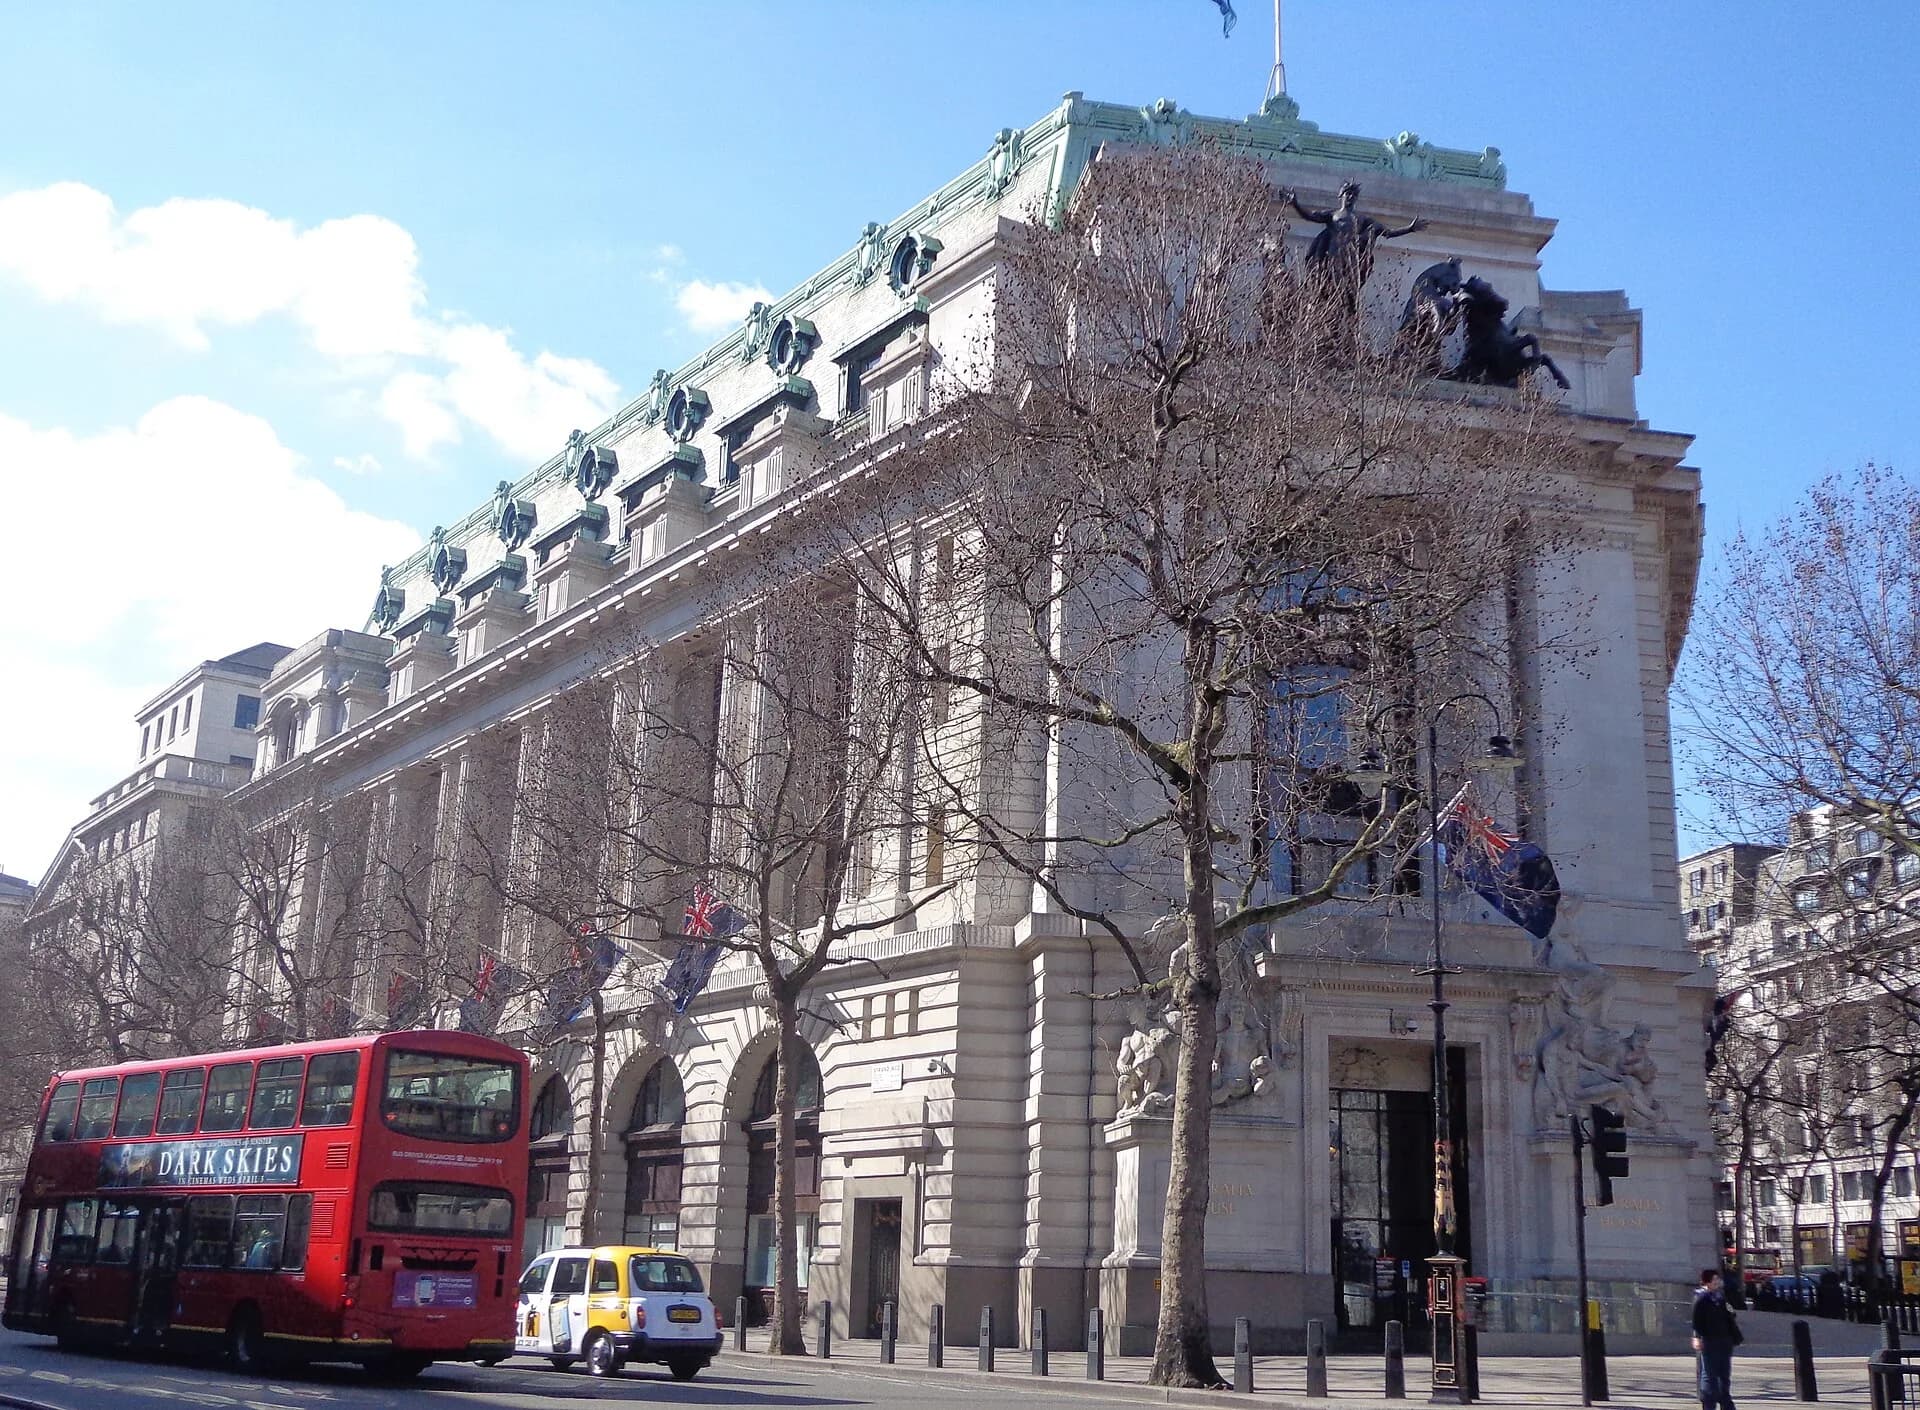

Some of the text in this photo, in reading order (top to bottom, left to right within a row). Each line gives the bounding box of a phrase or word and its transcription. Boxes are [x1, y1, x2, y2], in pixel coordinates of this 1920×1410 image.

[158, 1146, 292, 1176] DARK SKIES
[187, 1176, 216, 1185] CINEMAS
